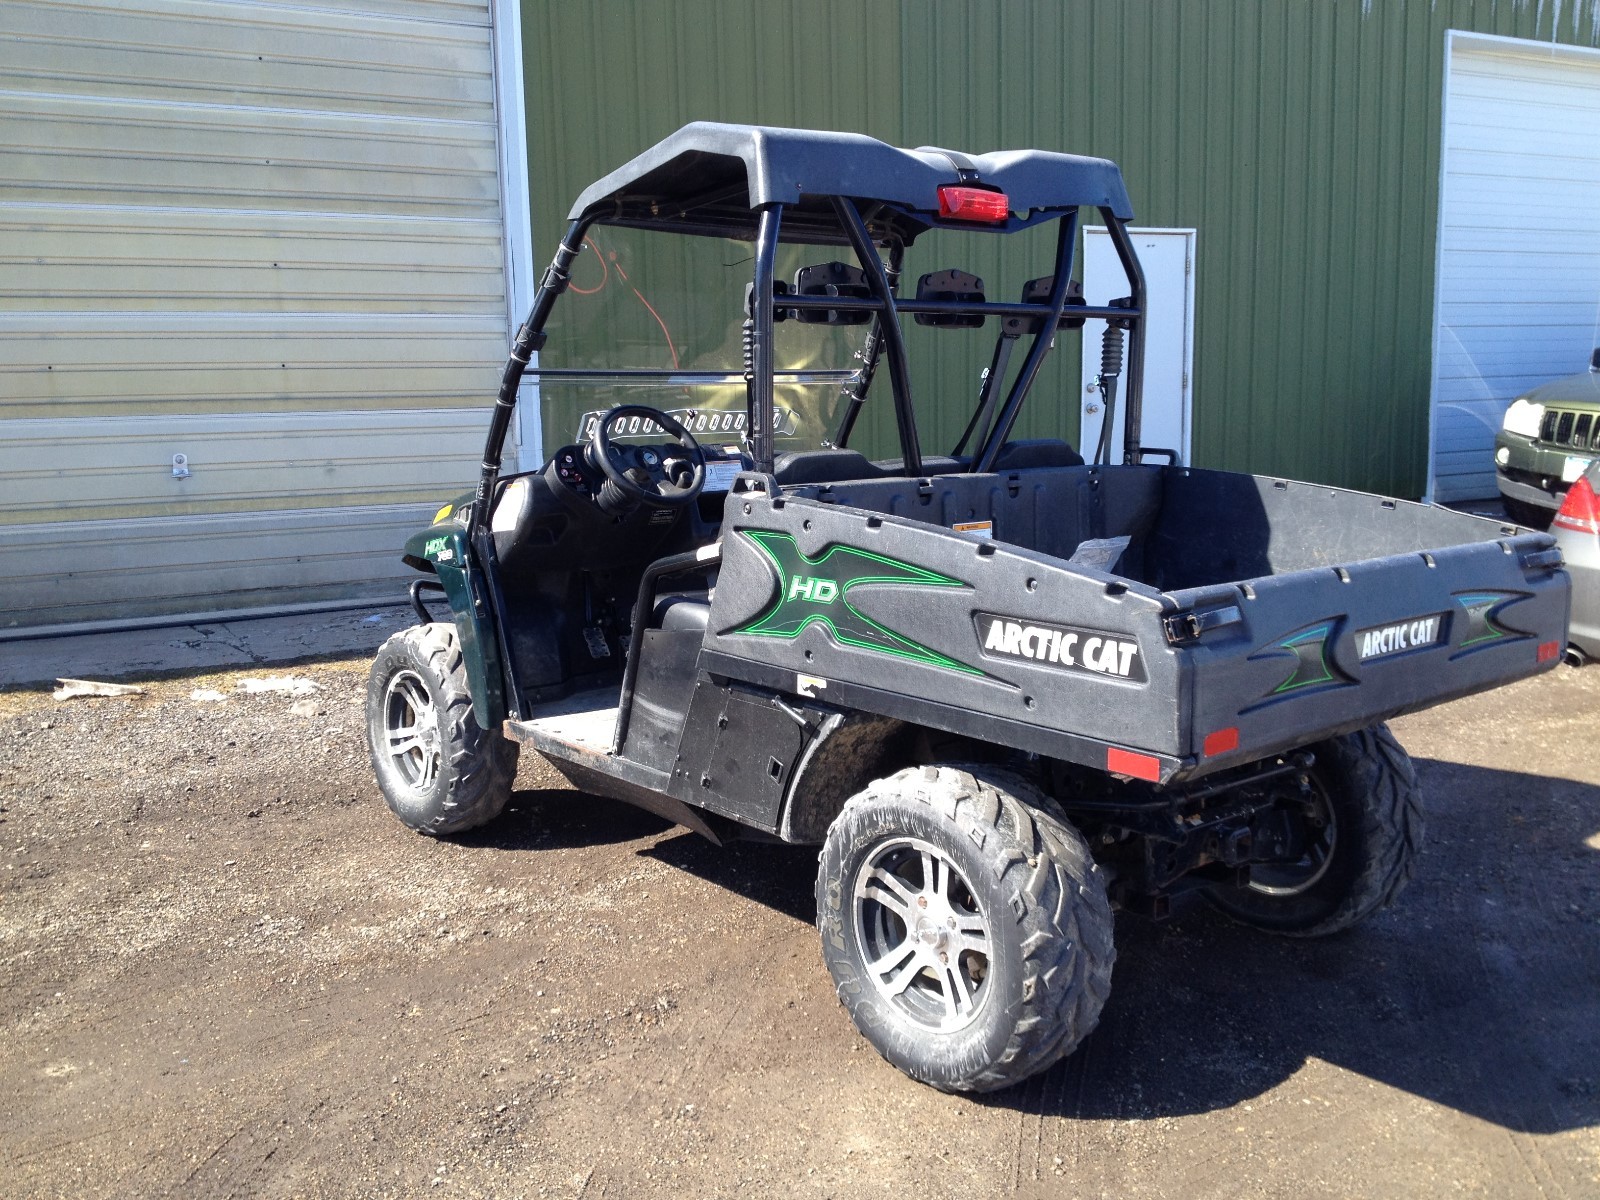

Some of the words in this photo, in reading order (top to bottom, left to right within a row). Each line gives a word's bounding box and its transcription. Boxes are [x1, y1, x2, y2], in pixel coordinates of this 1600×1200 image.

[424, 535, 449, 558] HDX
[787, 575, 839, 604] HD
[984, 619, 1079, 666] ARCTIC
[1082, 637, 1138, 677] CAT
[1361, 623, 1408, 658] ARCTIC
[1410, 618, 1434, 646] CAT
